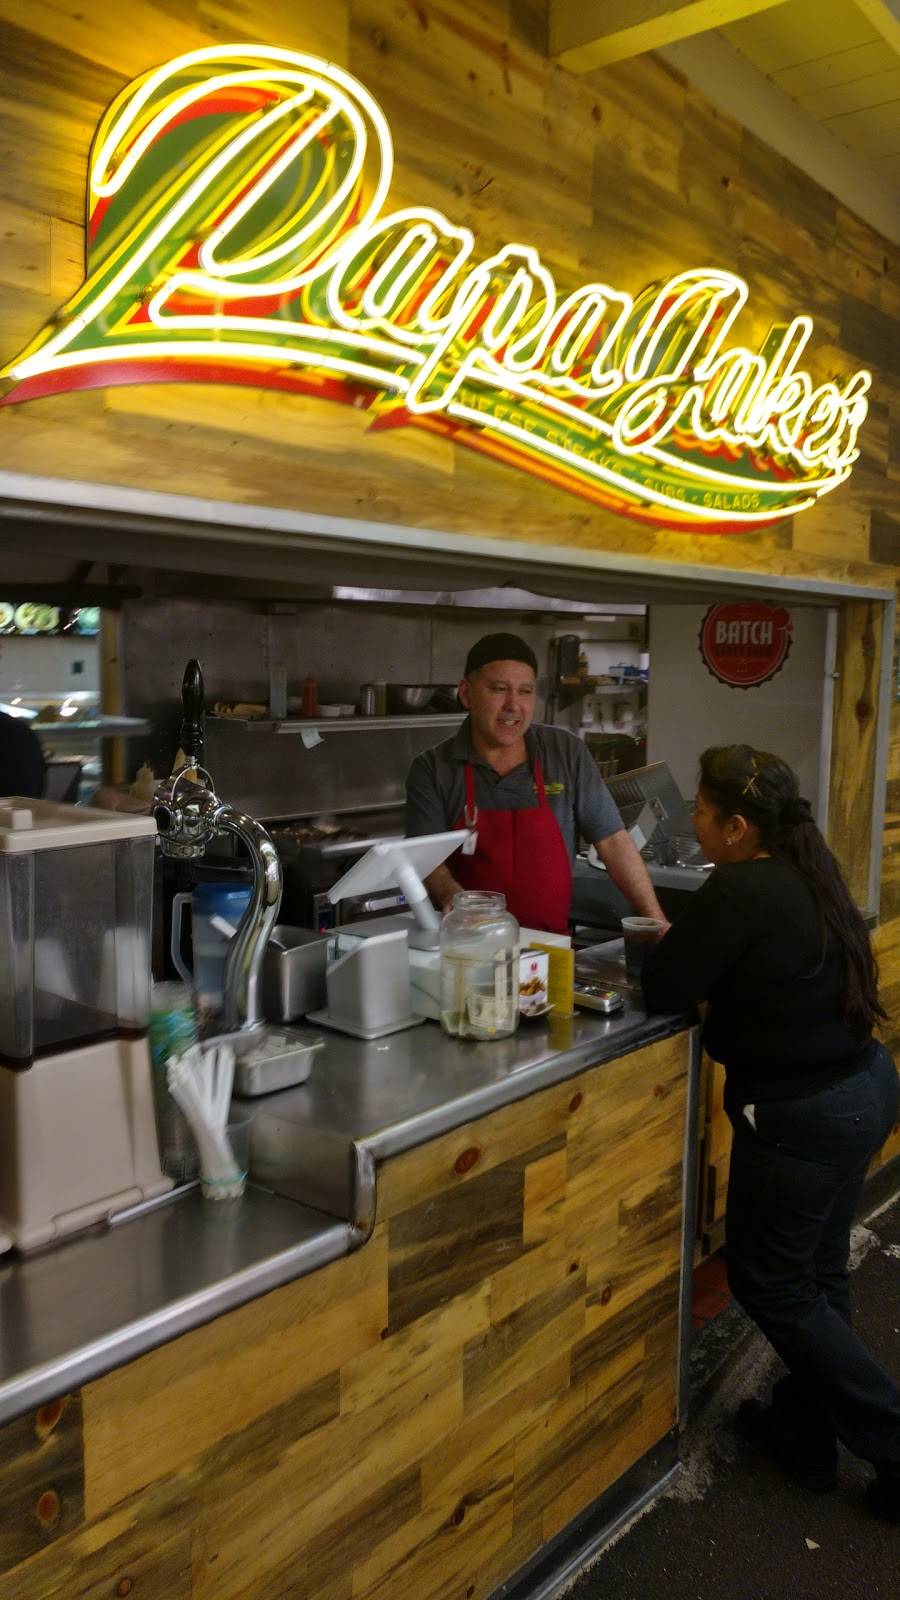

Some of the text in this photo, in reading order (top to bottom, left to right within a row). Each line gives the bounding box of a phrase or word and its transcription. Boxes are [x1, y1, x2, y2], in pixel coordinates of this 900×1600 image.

[3, 43, 635, 414] Papa
[703, 490, 760, 510] SALADS
[715, 620, 774, 645] BATCH
